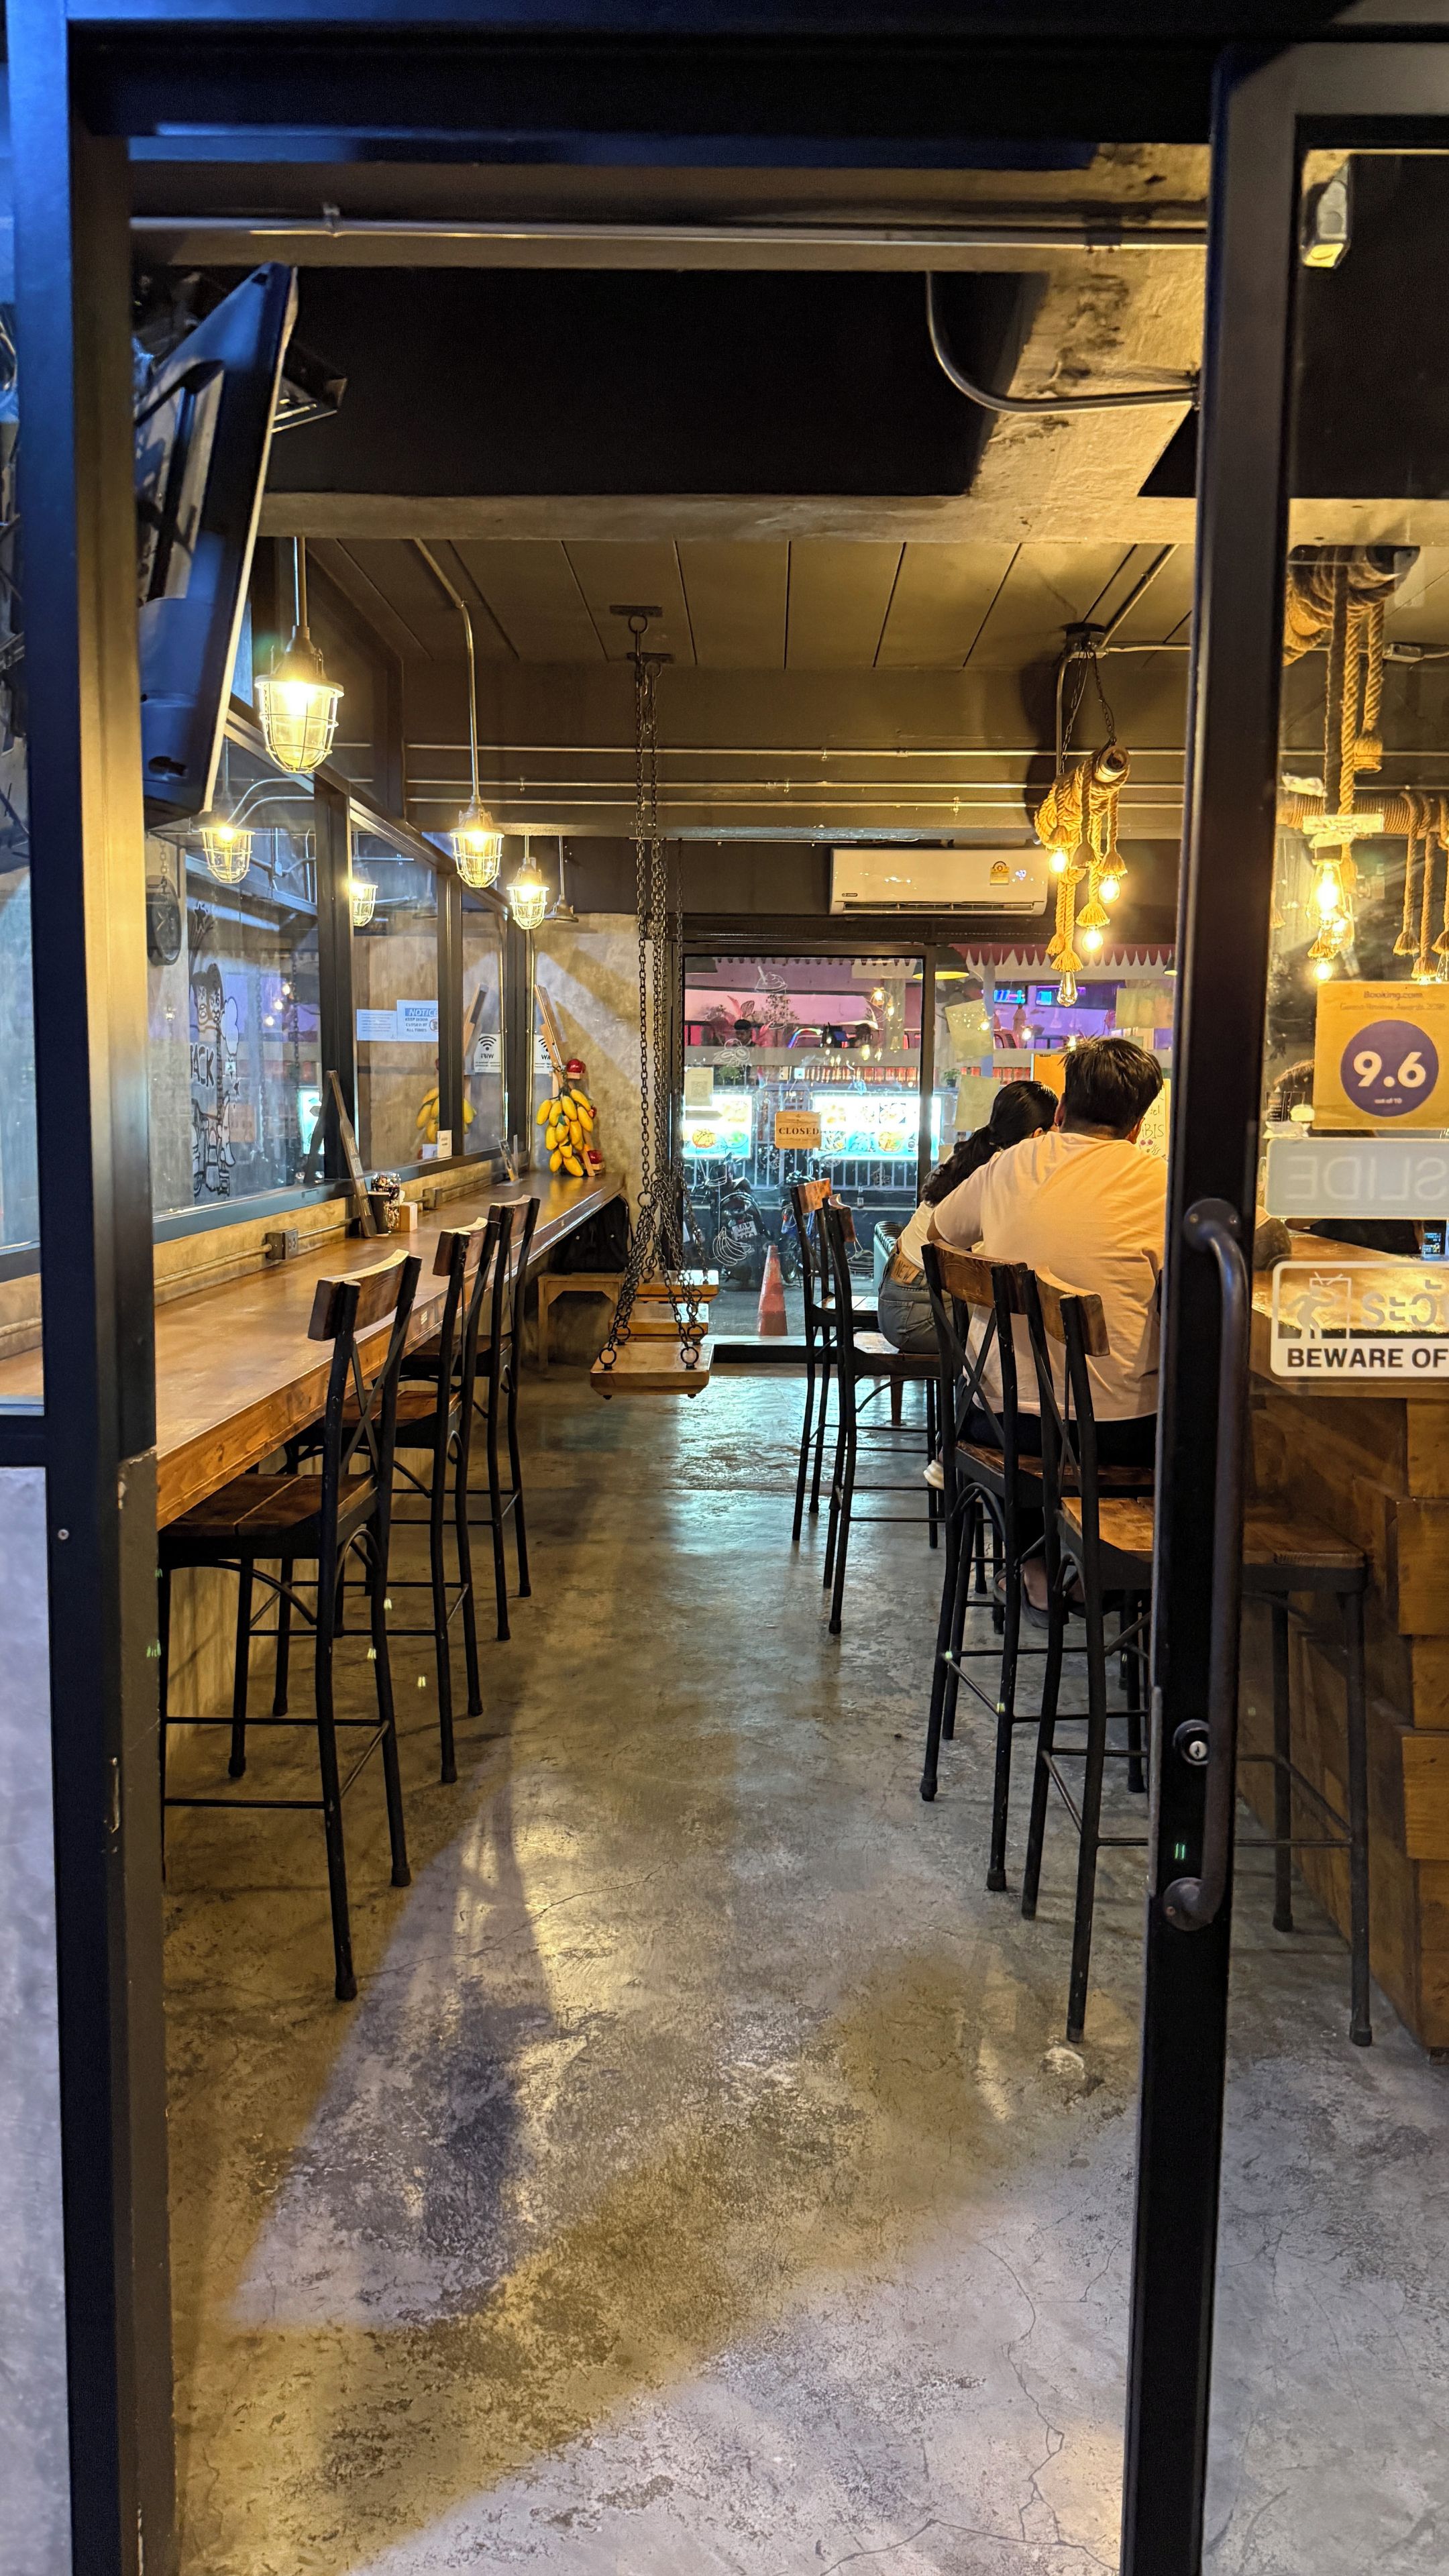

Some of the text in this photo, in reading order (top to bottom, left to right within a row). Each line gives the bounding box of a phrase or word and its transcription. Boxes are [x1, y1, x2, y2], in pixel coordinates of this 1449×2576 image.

[1353, 1051, 1426, 1087] 9.6
[1361, 1279, 1449, 1328] ระวั
[1287, 1348, 1448, 1368] BEWARE OF
